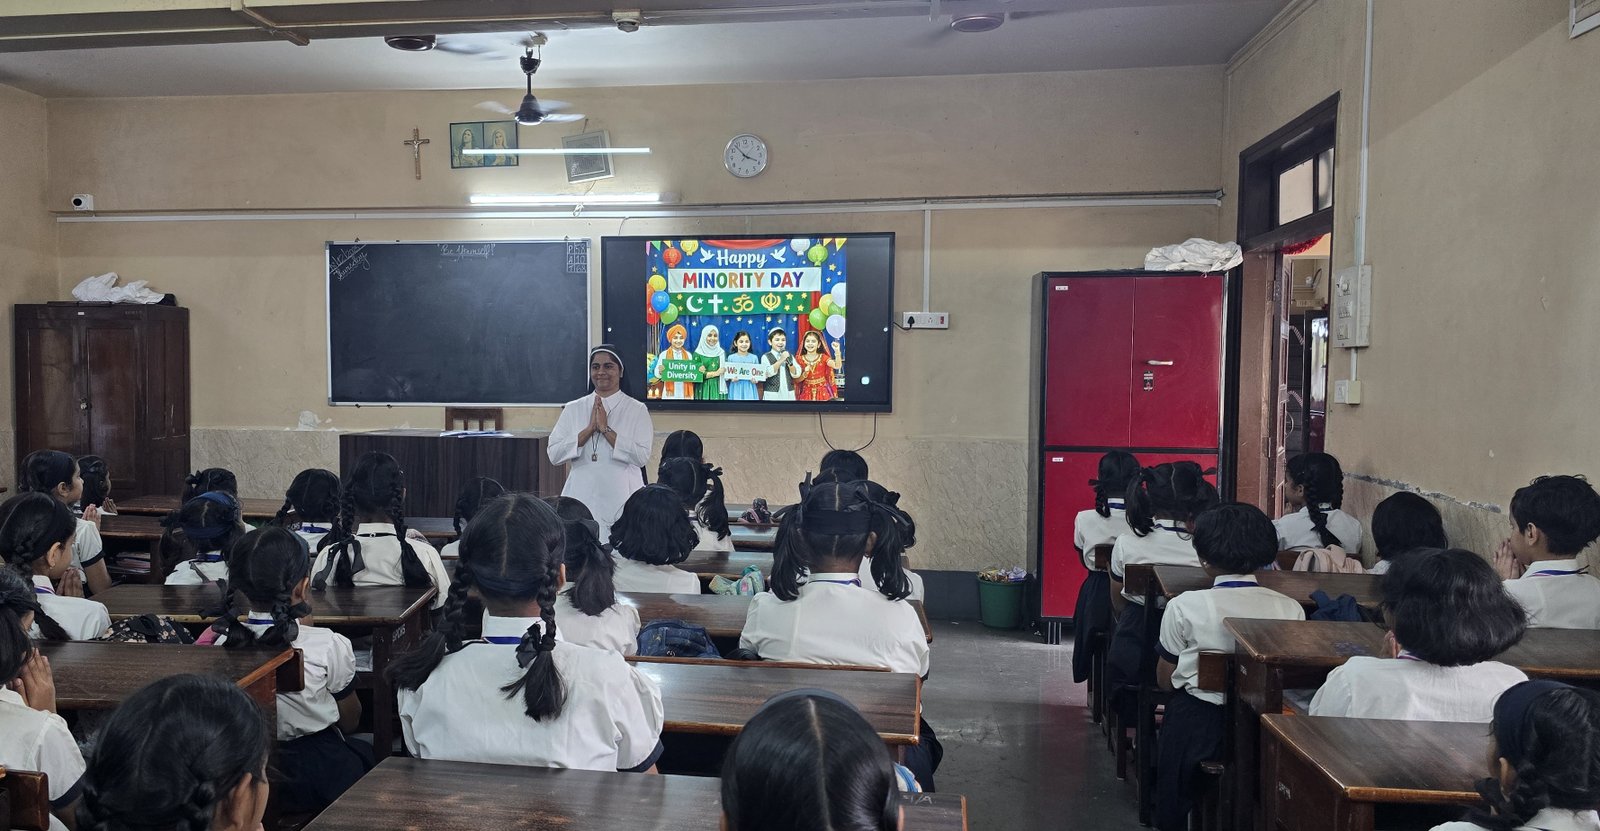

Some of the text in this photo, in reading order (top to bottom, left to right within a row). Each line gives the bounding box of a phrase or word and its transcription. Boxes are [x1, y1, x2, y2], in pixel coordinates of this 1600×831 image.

[716, 248, 767, 268] Happy
[682, 271, 804, 289] MINORITY DAY
[668, 362, 696, 371] Unity in
[727, 366, 764, 377] We Are One
[667, 371, 698, 381] Diversity
